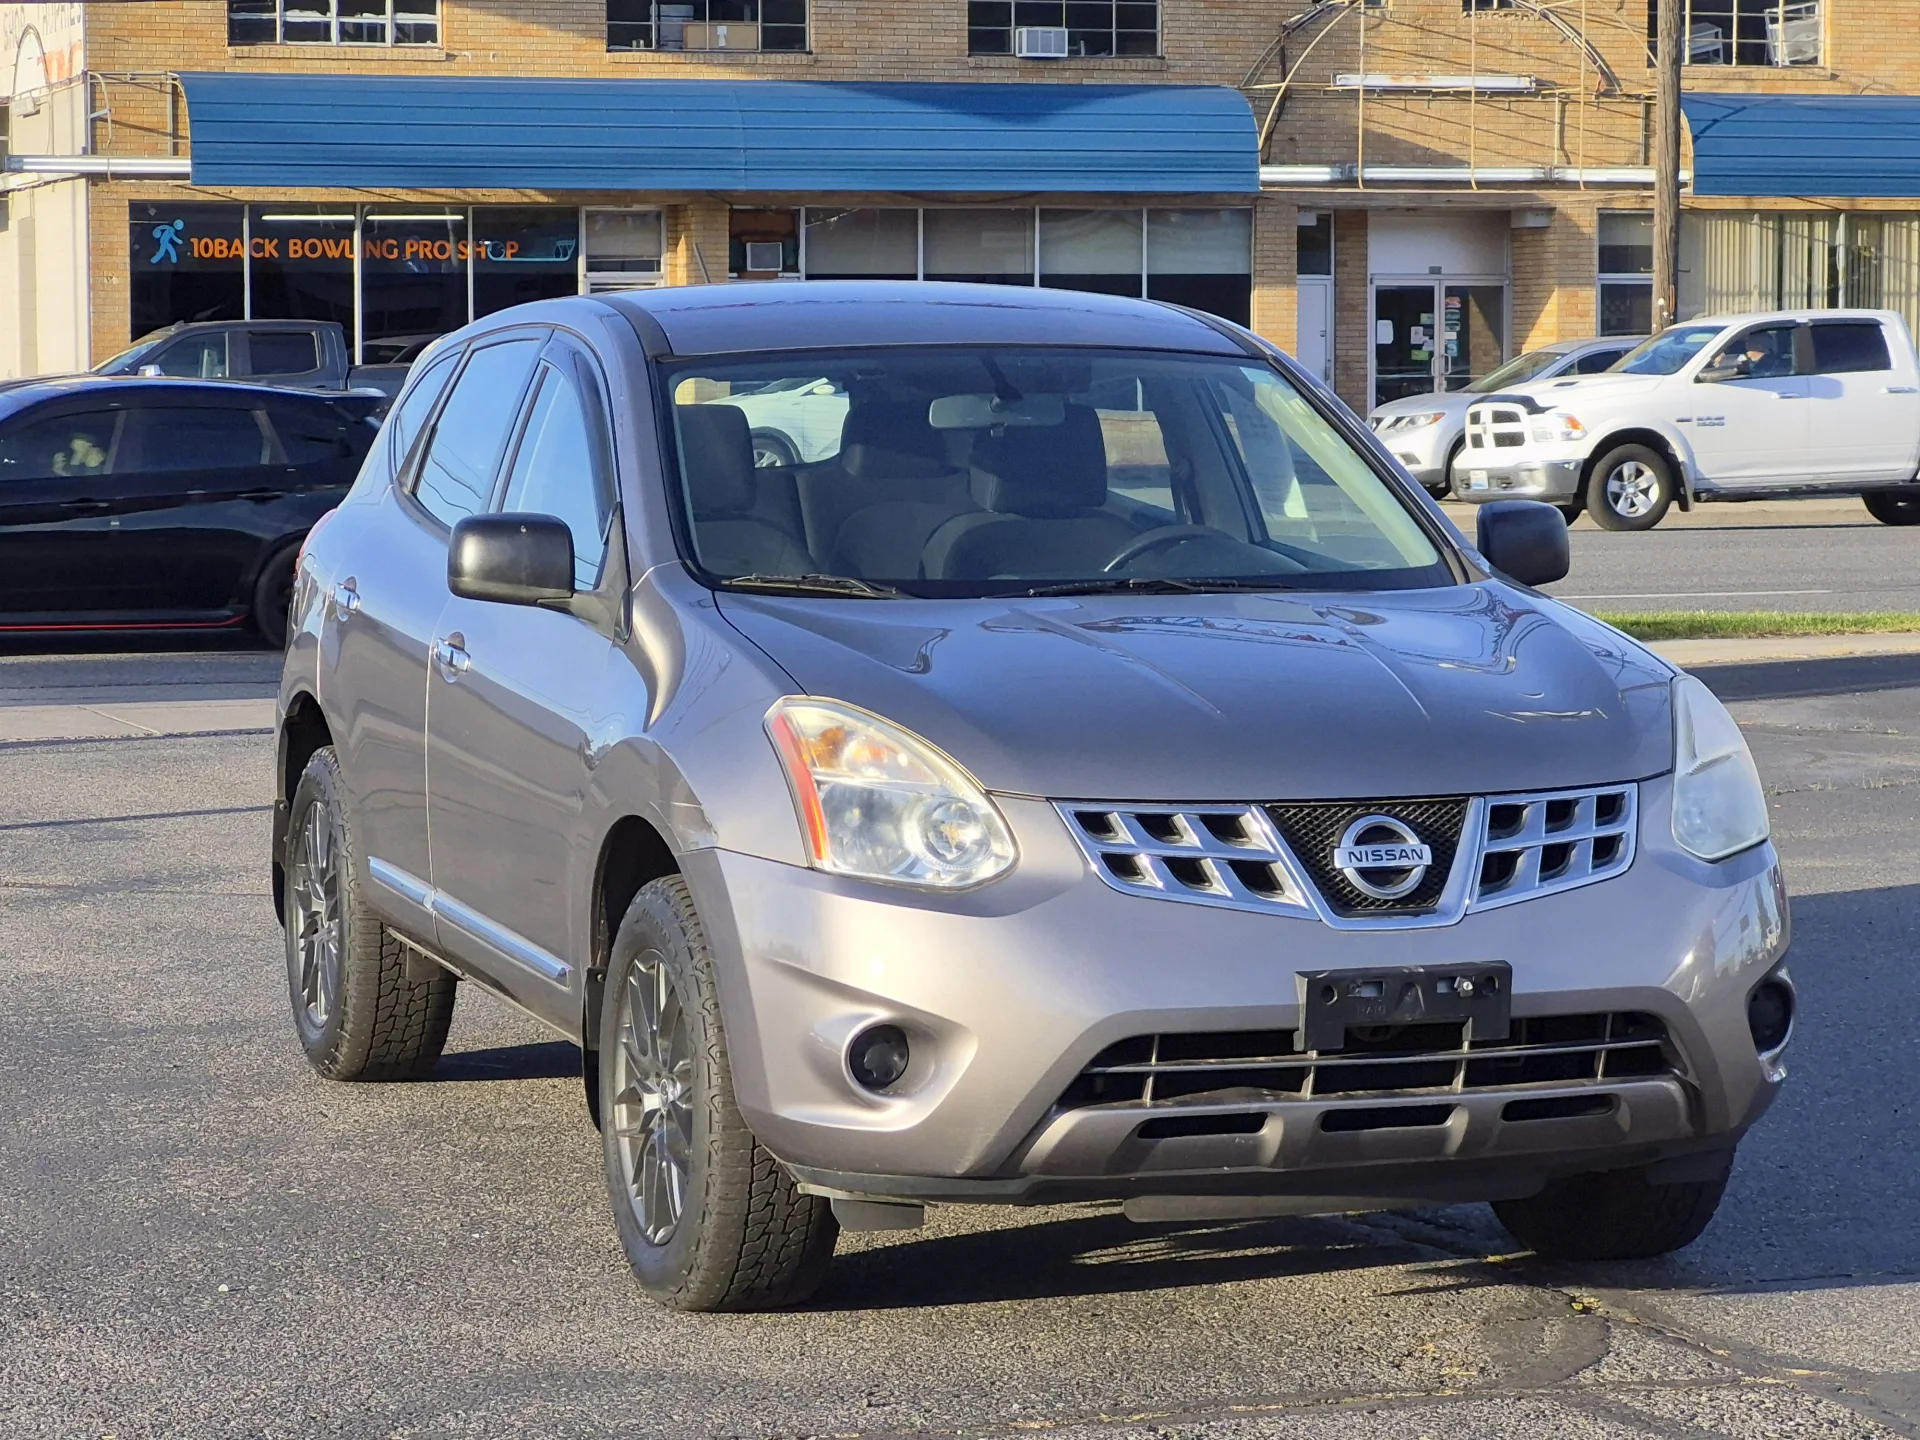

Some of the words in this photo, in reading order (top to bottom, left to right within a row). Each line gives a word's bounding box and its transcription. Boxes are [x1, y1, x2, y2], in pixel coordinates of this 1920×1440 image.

[190, 238, 279, 259] 10BACK
[288, 238, 399, 259] BOWLING
[405, 239, 451, 260] PRO
[1348, 848, 1424, 863] NISSAN
